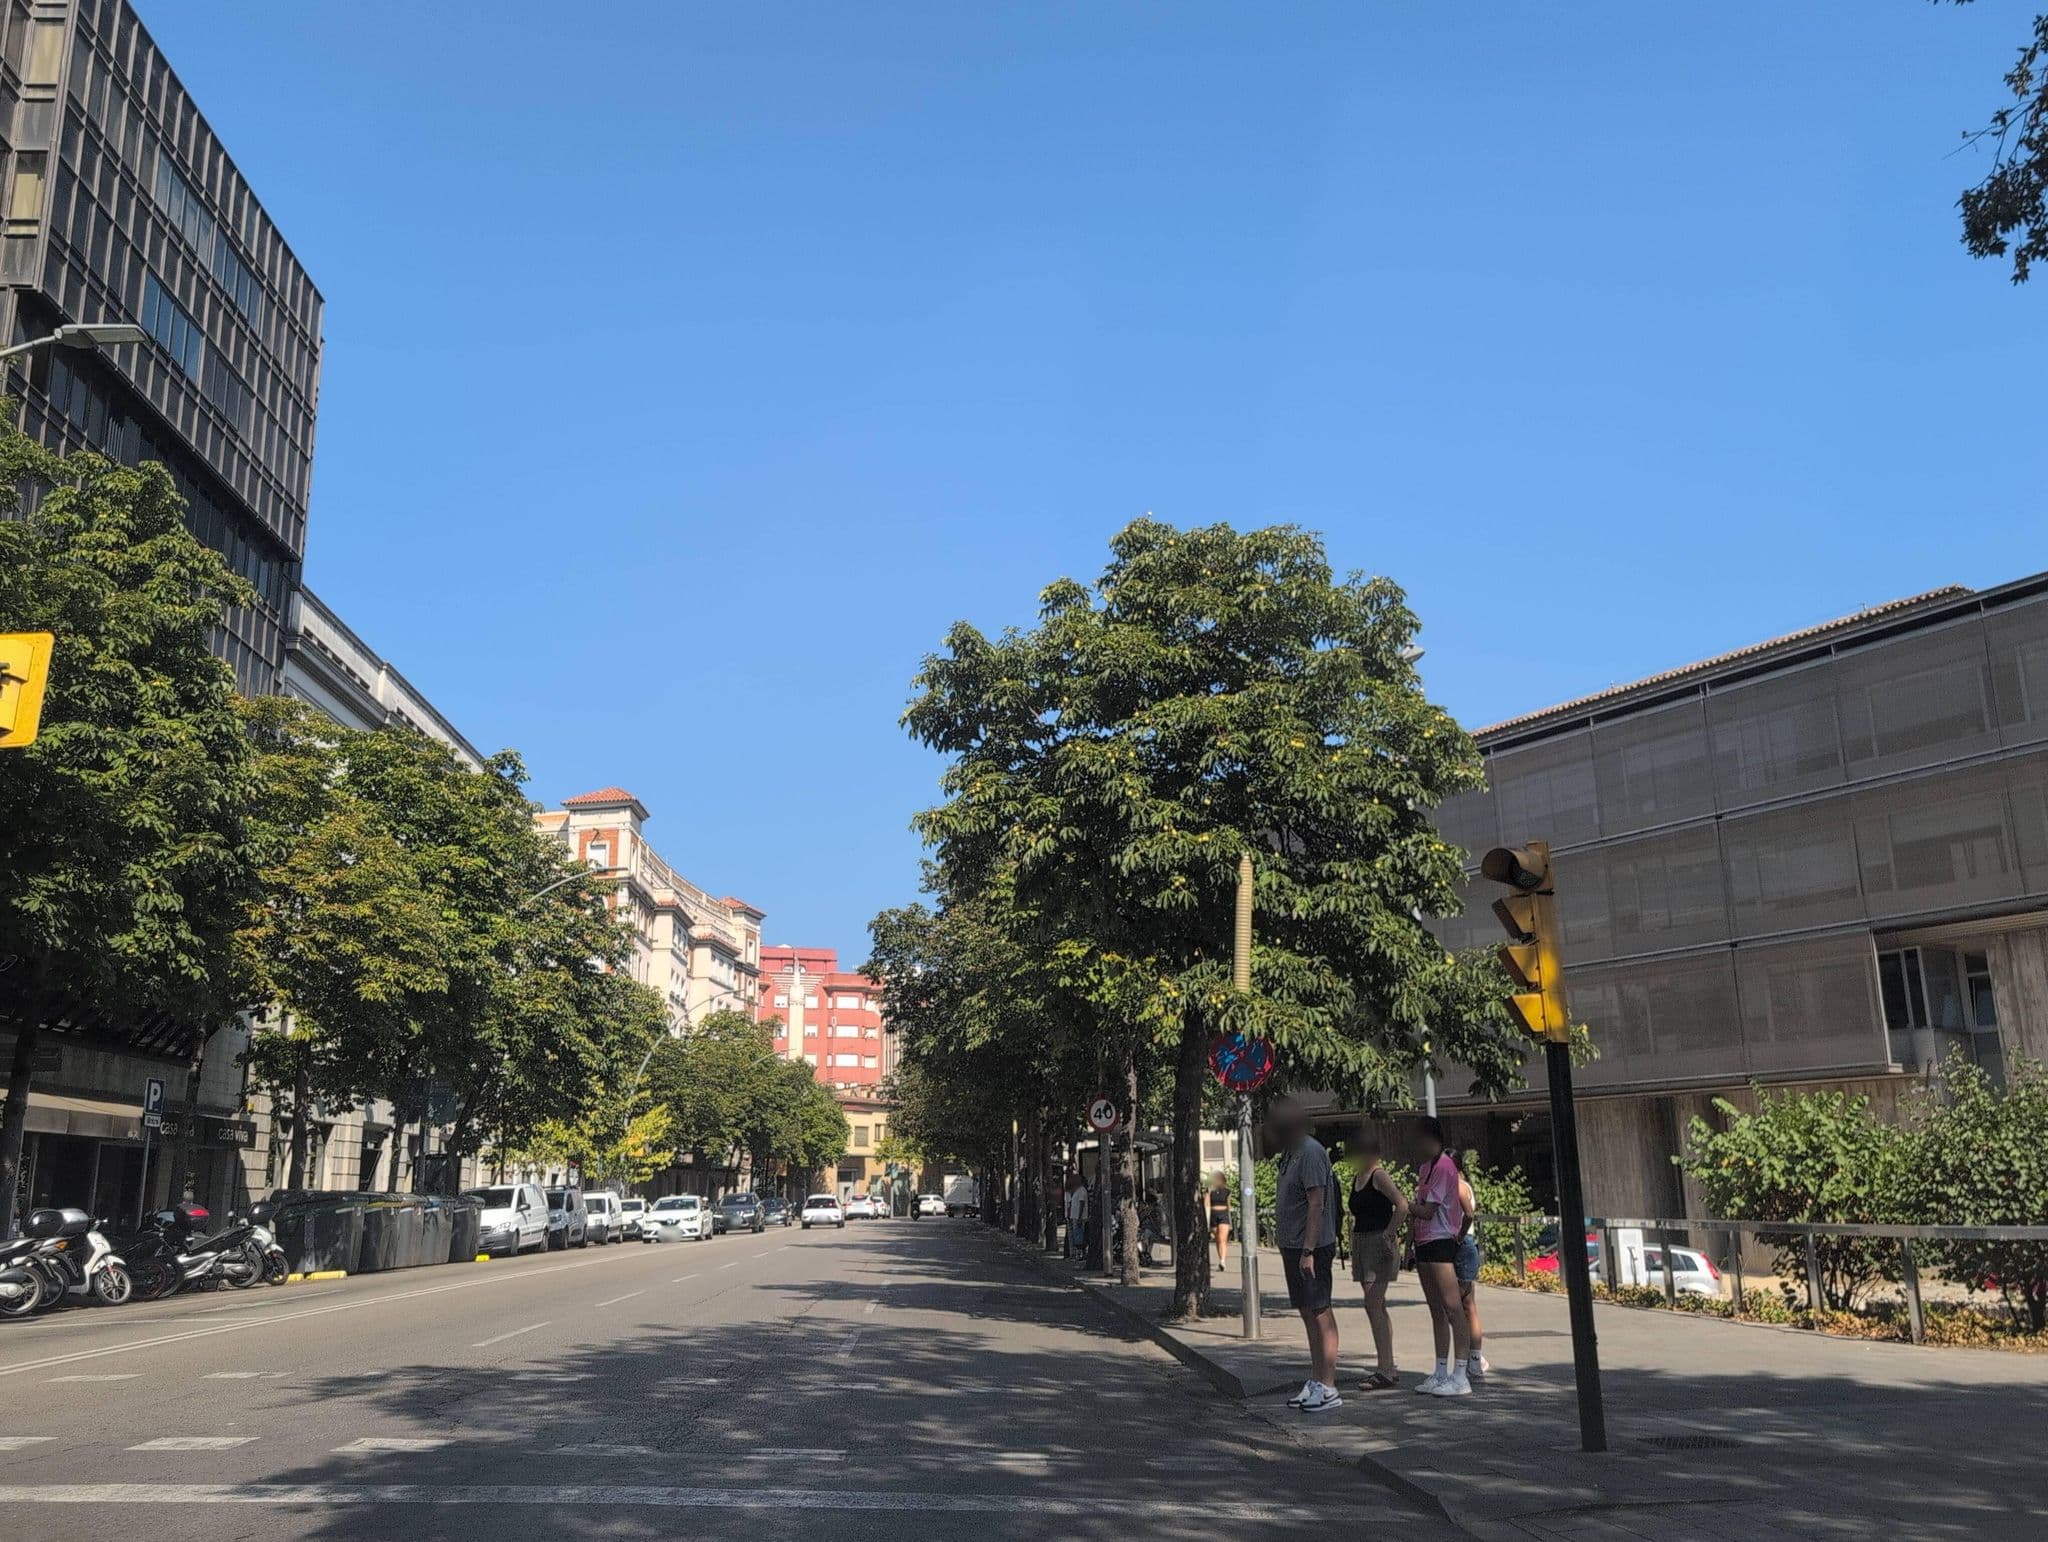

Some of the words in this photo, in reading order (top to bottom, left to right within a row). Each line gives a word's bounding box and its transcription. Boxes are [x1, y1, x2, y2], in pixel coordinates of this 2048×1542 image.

[149, 1082, 161, 1110] P
[1093, 1106, 1113, 1120] 40
[218, 1128, 234, 1141] casa
[234, 1124, 249, 1142] viva
